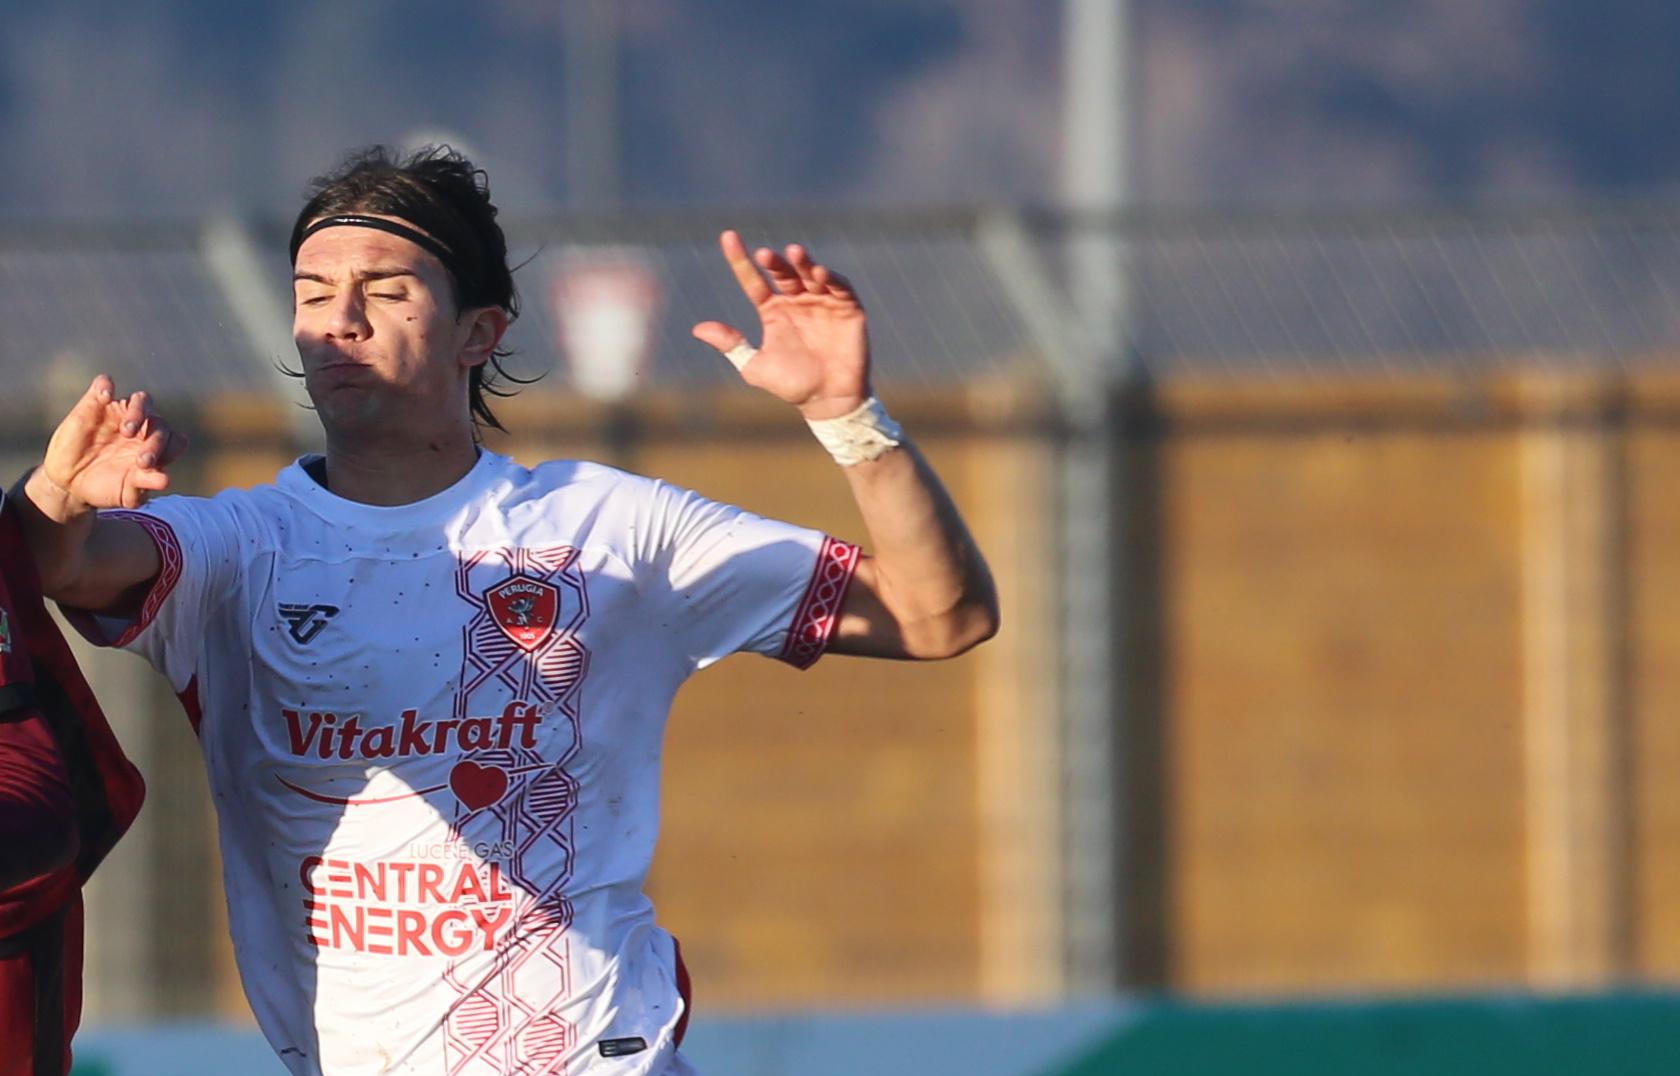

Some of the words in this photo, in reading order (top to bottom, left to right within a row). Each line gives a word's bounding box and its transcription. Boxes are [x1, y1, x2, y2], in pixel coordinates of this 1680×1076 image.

[498, 583, 544, 599] PERUGIA
[282, 701, 543, 760] Vitakraft
[474, 842, 514, 859] GAS
[299, 856, 512, 904] CENTRAL
[303, 899, 513, 957] ENERGY
